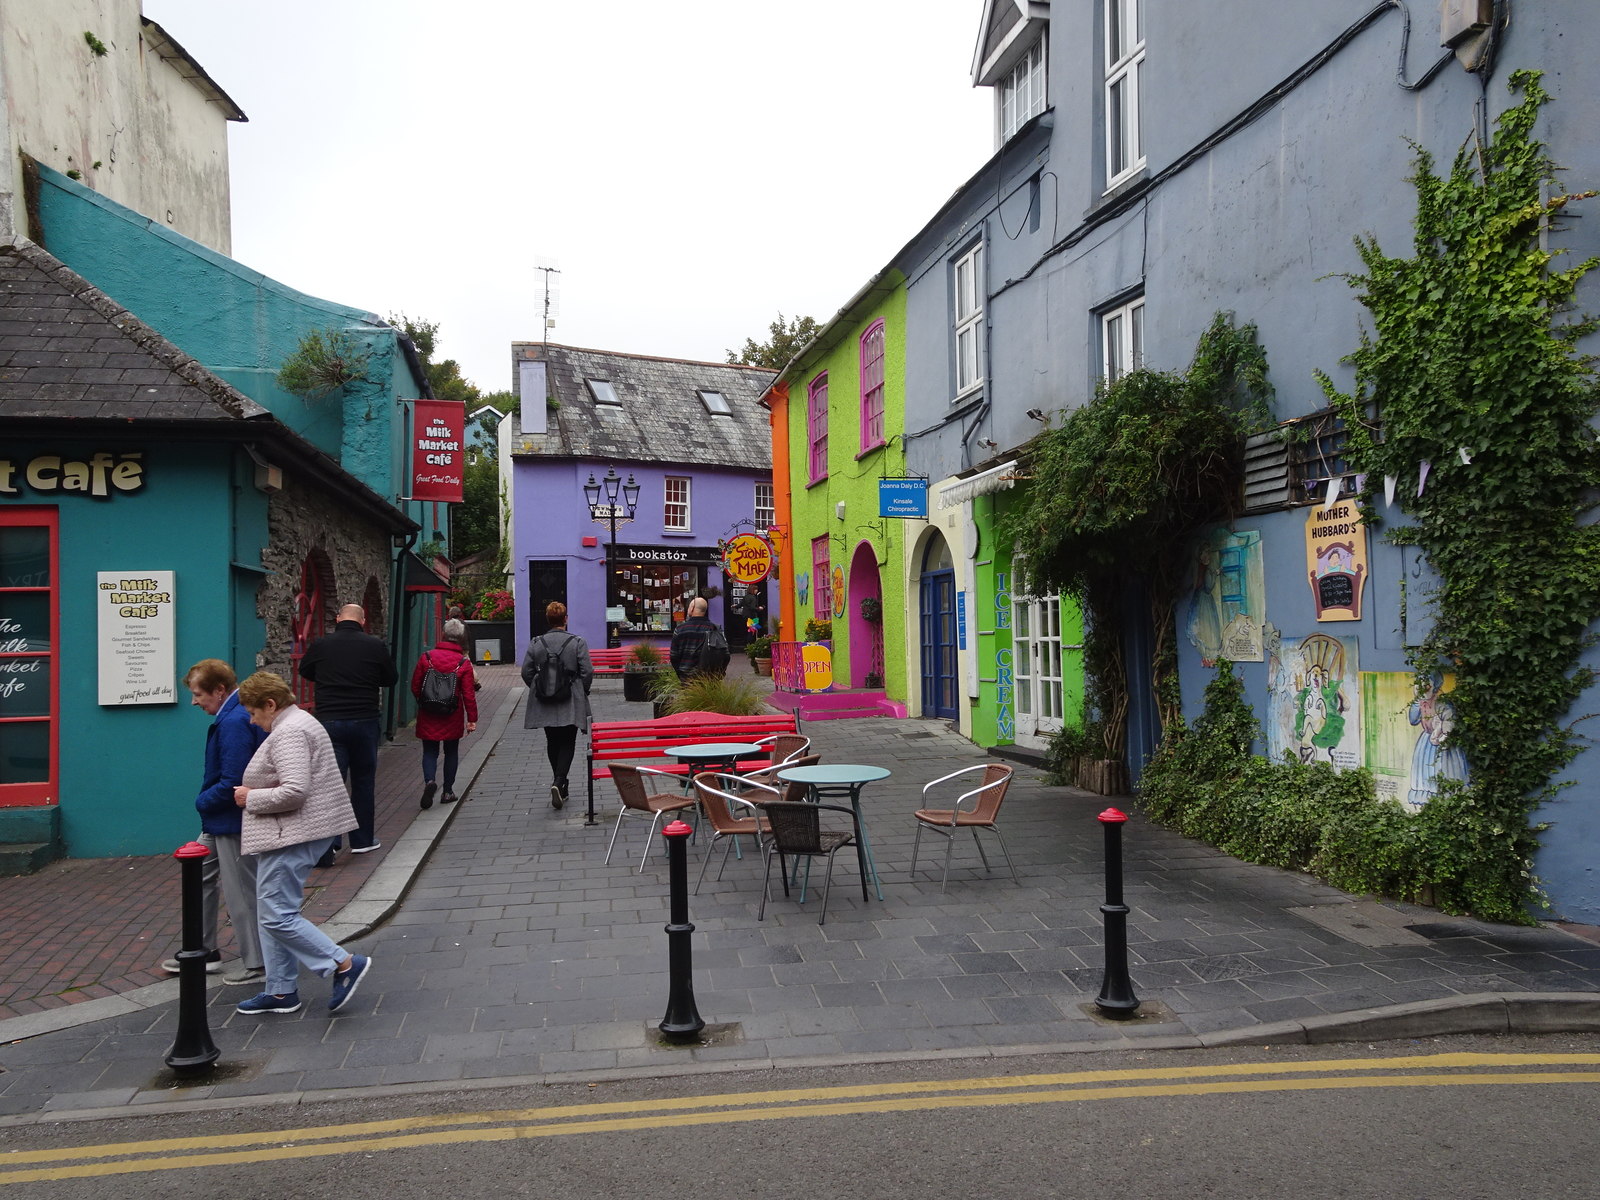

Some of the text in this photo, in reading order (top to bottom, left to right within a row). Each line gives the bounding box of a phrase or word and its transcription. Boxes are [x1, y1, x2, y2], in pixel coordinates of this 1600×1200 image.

[426, 426, 452, 438] Milk
[418, 439, 459, 451] Market
[426, 453, 452, 466] Café
[26, 453, 143, 496] Café
[416, 474, 460, 486] Great Food Daily
[1316, 506, 1349, 522] MOTHER
[1312, 522, 1357, 539] HUBBARD'S
[629, 549, 688, 561] bookstór
[733, 541, 769, 561] STONE
[736, 561, 767, 576] MAD
[120, 579, 158, 591] Milk
[110, 592, 171, 604] Market
[995, 573, 1011, 629] ICE
[120, 605, 158, 619] Café
[0, 638, 28, 653] ilk
[119, 686, 173, 703] great food all day
[996, 648, 1014, 740] CREAM
